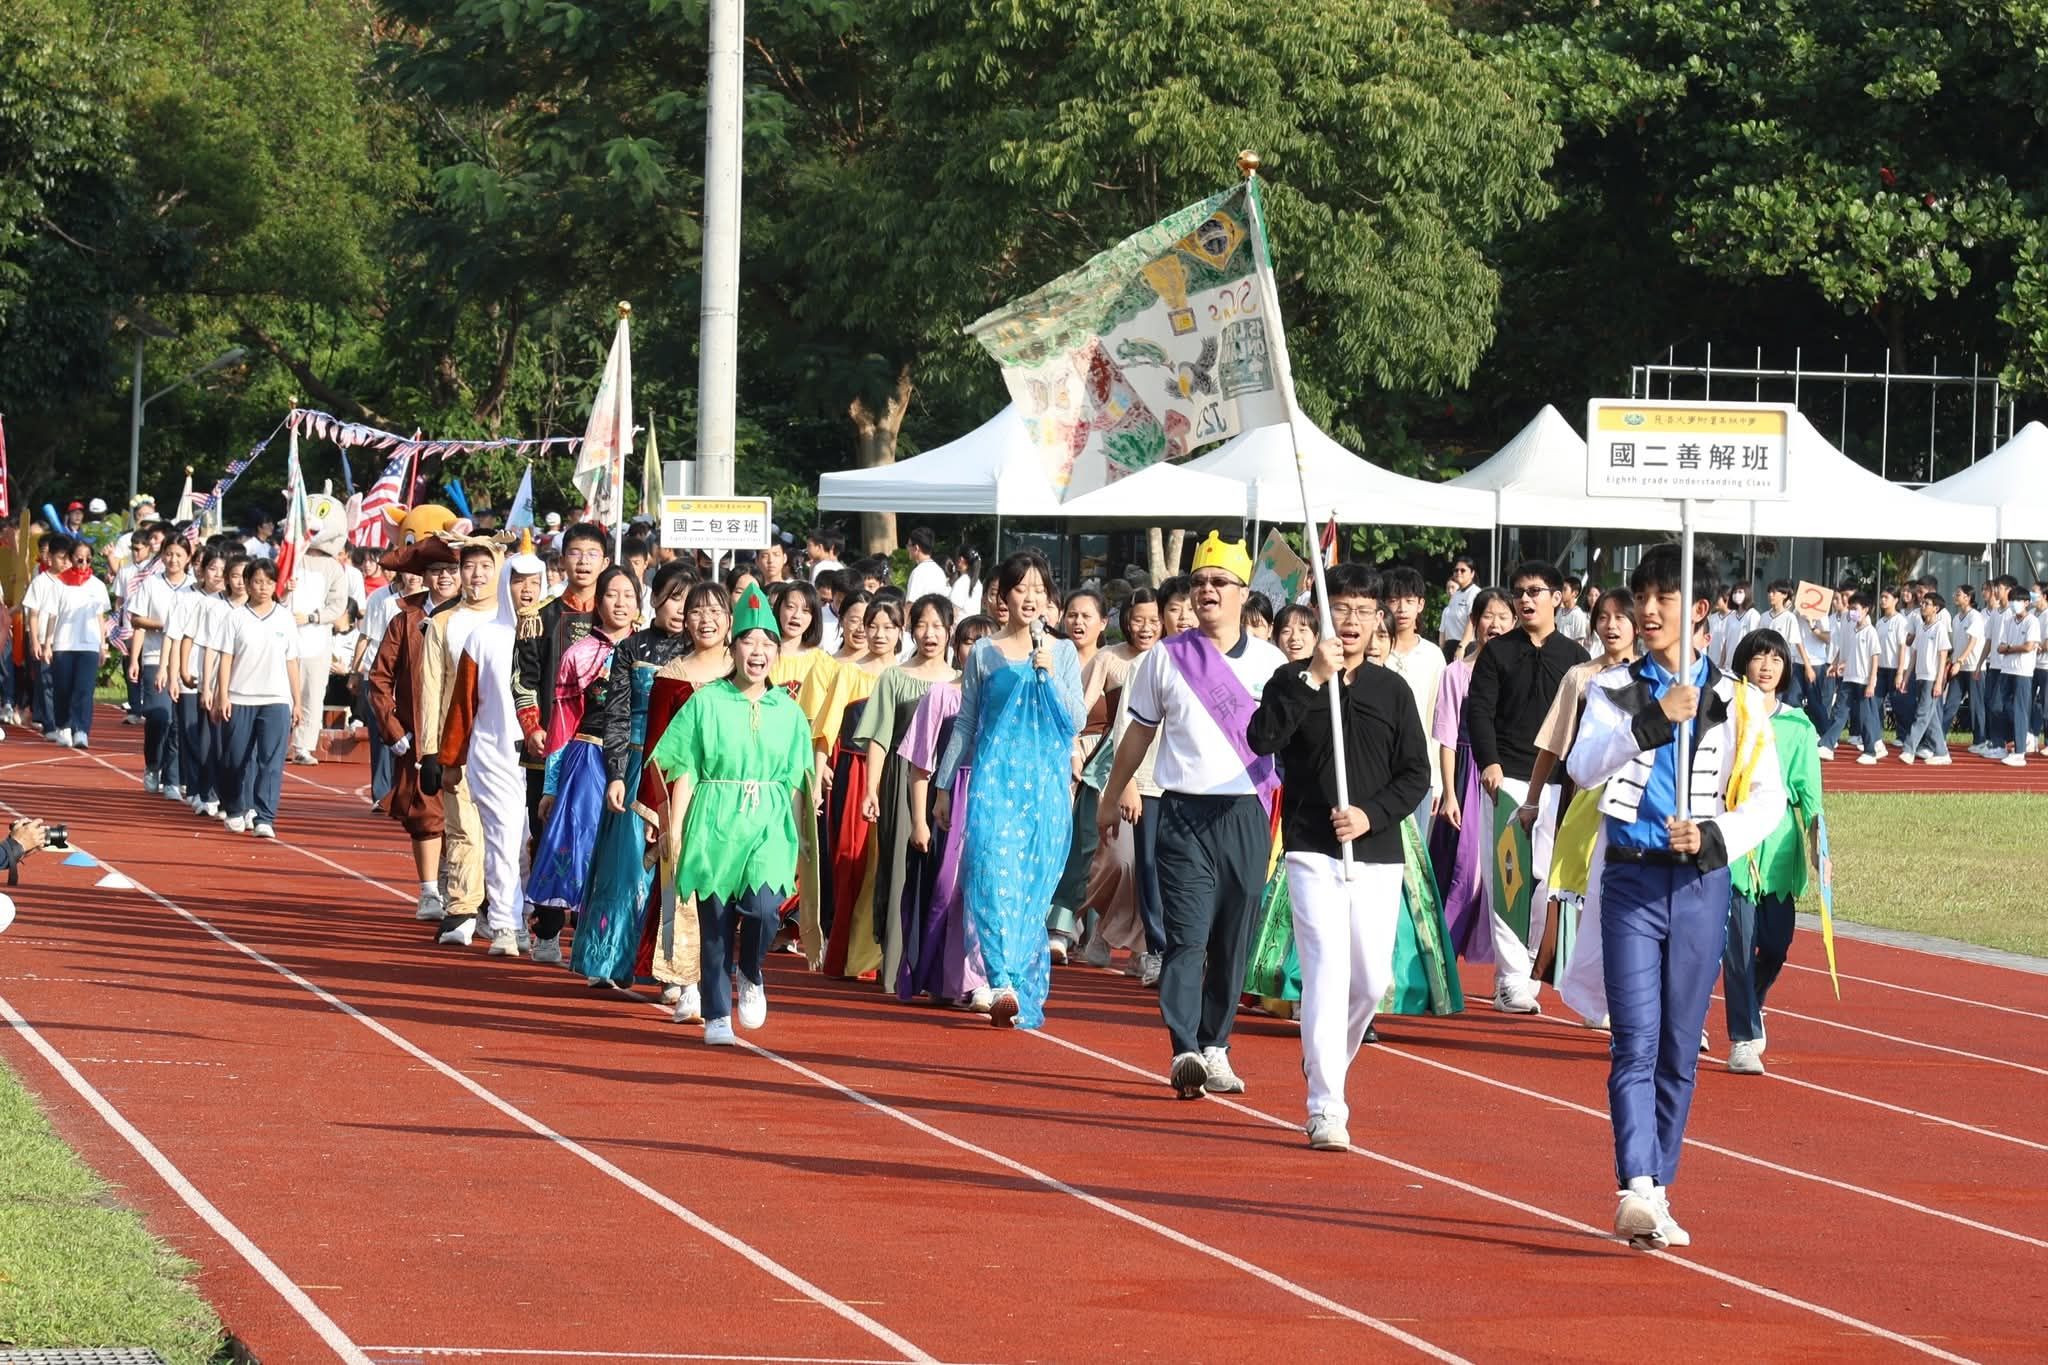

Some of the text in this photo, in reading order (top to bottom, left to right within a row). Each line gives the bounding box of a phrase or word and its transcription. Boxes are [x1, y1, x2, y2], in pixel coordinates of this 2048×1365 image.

[1610, 442, 1769, 471] 國二善解班
[1606, 475, 1772, 488] Eighth grade Understanding Class
[673, 518, 759, 533] 國二包容班
[1800, 587, 1827, 613] 2
[1209, 682, 1244, 721] 最
